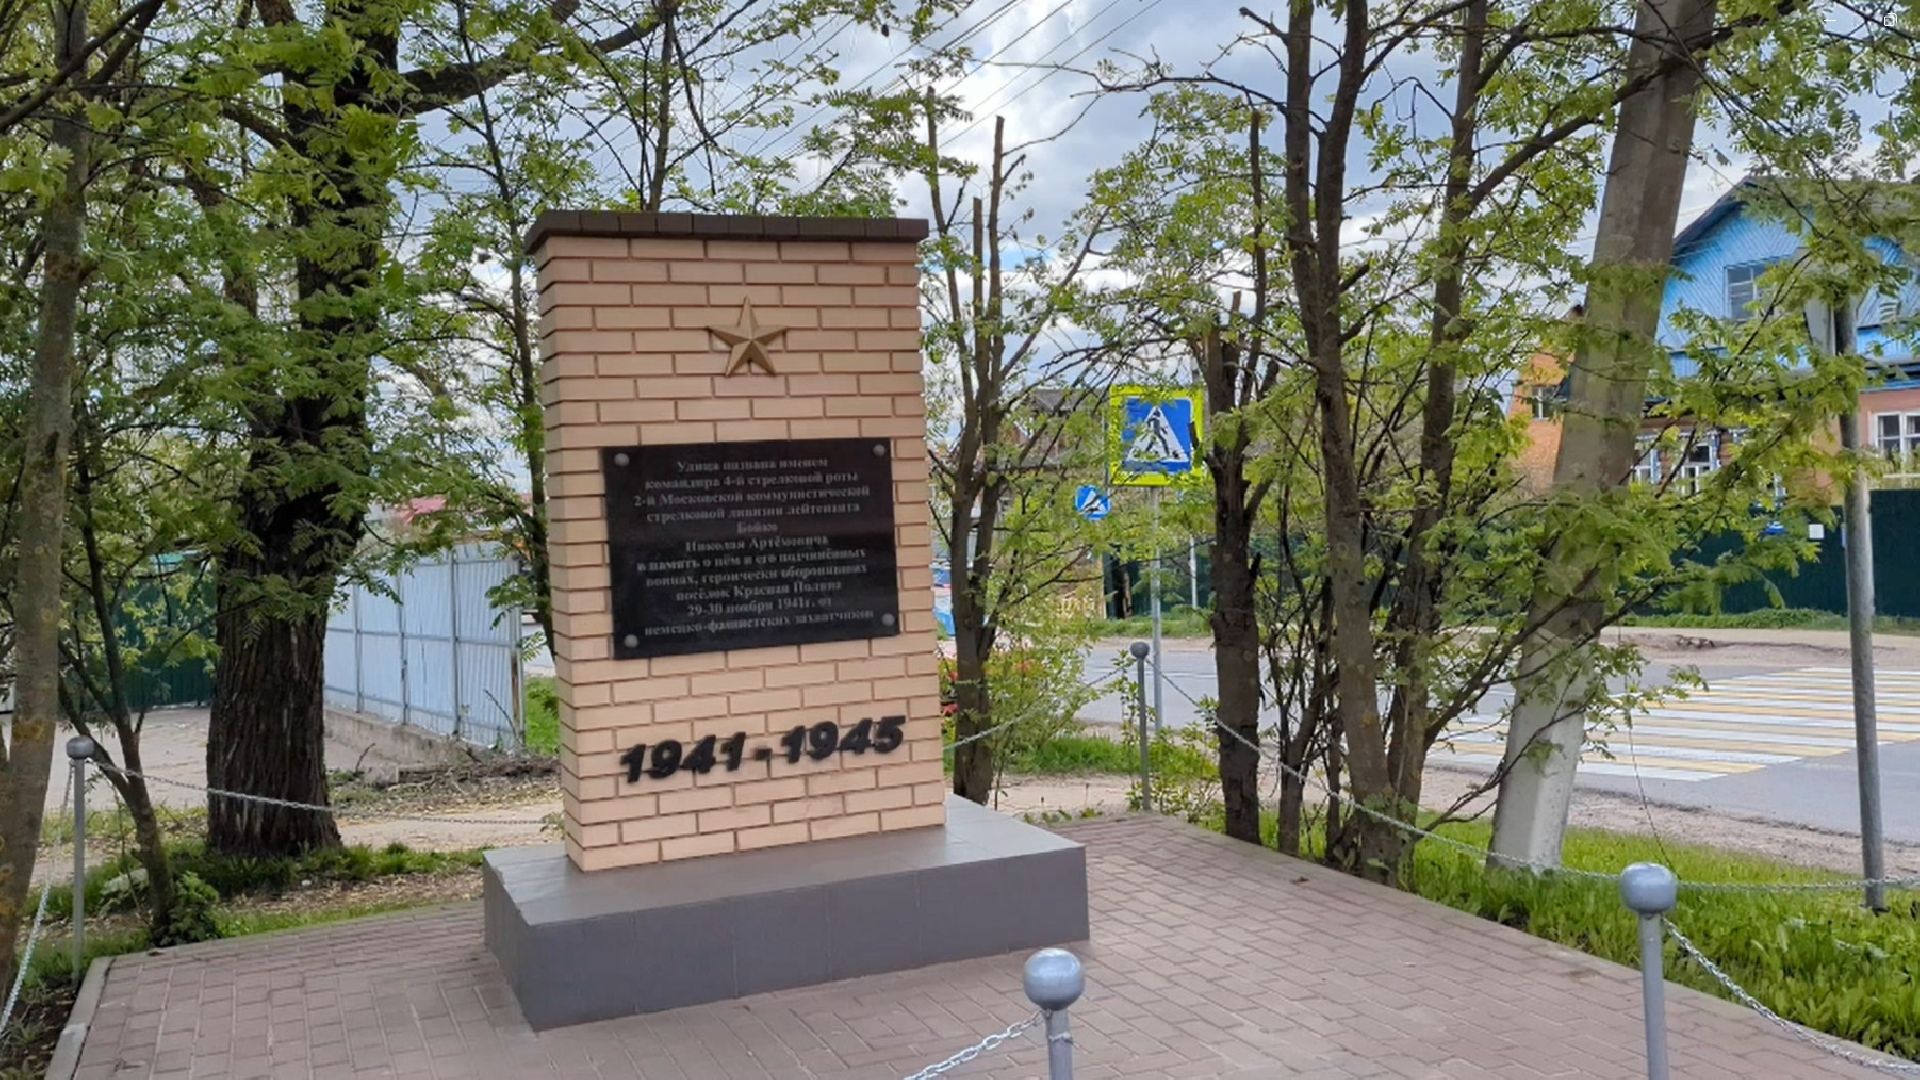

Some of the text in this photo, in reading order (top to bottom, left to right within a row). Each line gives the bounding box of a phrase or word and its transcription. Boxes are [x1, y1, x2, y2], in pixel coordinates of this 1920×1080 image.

[677, 458, 828, 473] Улица названа именем
[645, 471, 858, 491] командира 4-й стрелковой роты
[633, 485, 871, 507] 2-й Московской коммунистический
[646, 503, 861, 525] стрелковой дивизии лейтенанта
[685, 540, 745, 552] Николая
[636, 547, 866, 571] в память о нём и его подчинённых
[646, 564, 867, 588] воинах, героически оборонивших
[676, 581, 842, 601] посёлок Красная Поляна
[687, 602, 724, 616] 29-30
[726, 599, 774, 614] ноября
[817, 597, 832, 608] от
[645, 610, 875, 636] немецко-фашистских захватчиков
